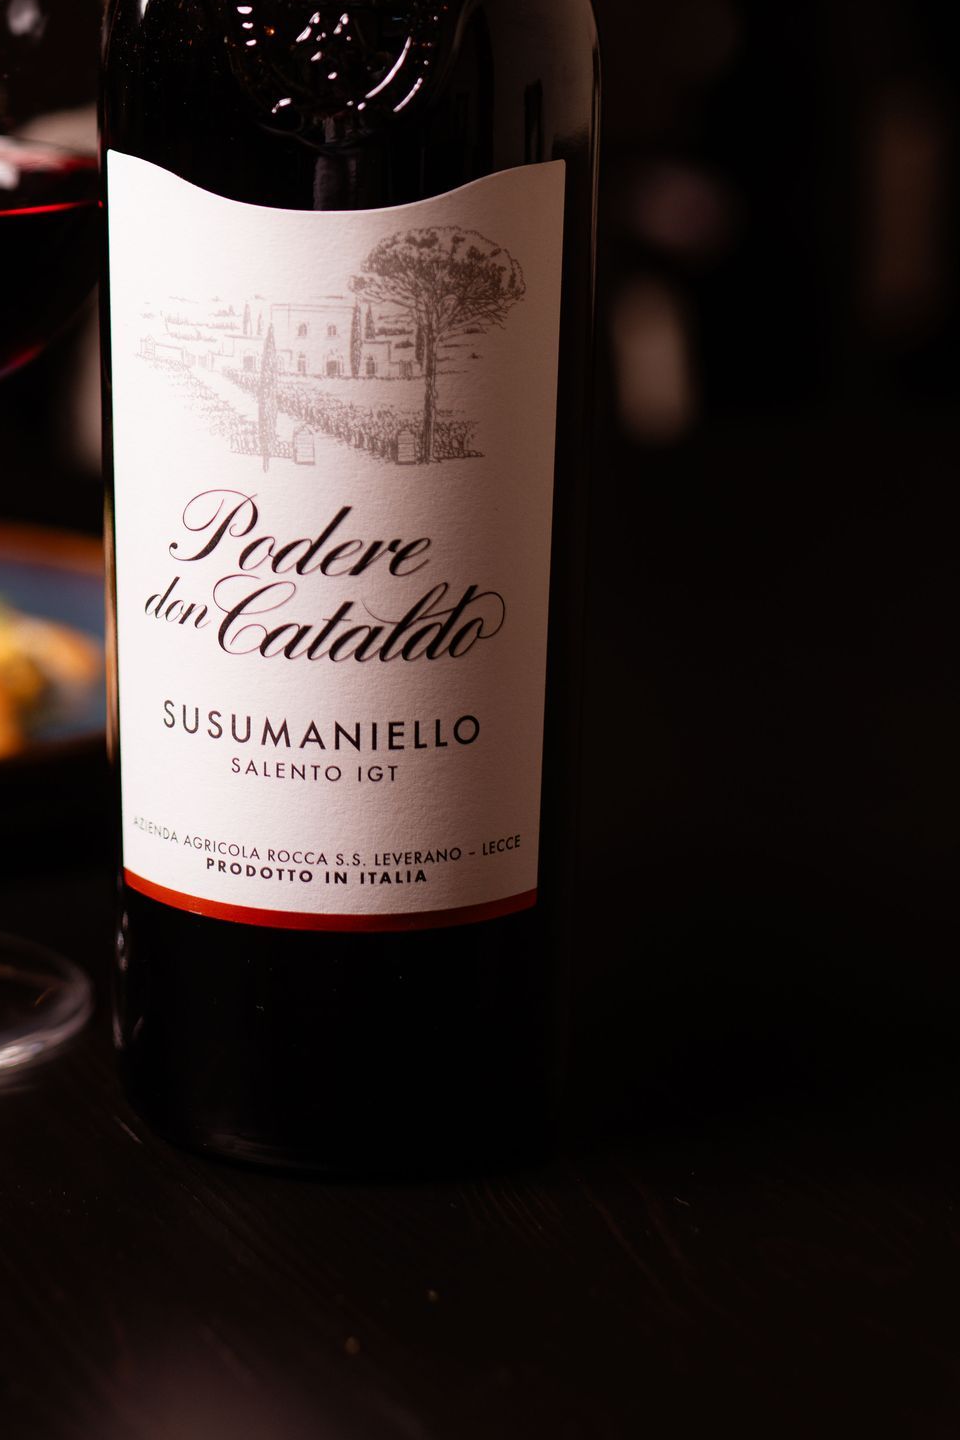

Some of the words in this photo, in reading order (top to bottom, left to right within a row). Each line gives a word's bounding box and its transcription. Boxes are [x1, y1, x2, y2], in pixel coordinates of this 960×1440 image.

[168, 489, 431, 577] Podere
[144, 576, 212, 629] don
[212, 573, 506, 662] Cataldo
[163, 699, 480, 752] SUSUMANIELLO
[231, 757, 342, 782] SALENTO
[357, 765, 399, 783] IGT
[133, 816, 178, 843] AZIENDA
[183, 834, 260, 860] AGRICOLA
[267, 848, 328, 866] ROCCA
[336, 852, 366, 867] S.S.
[374, 846, 462, 867] LEVERANO
[482, 833, 521, 856] LECCE
[206, 857, 313, 883] PRODOTTO
[325, 870, 348, 884] IN
[360, 869, 428, 885] ITALIA
